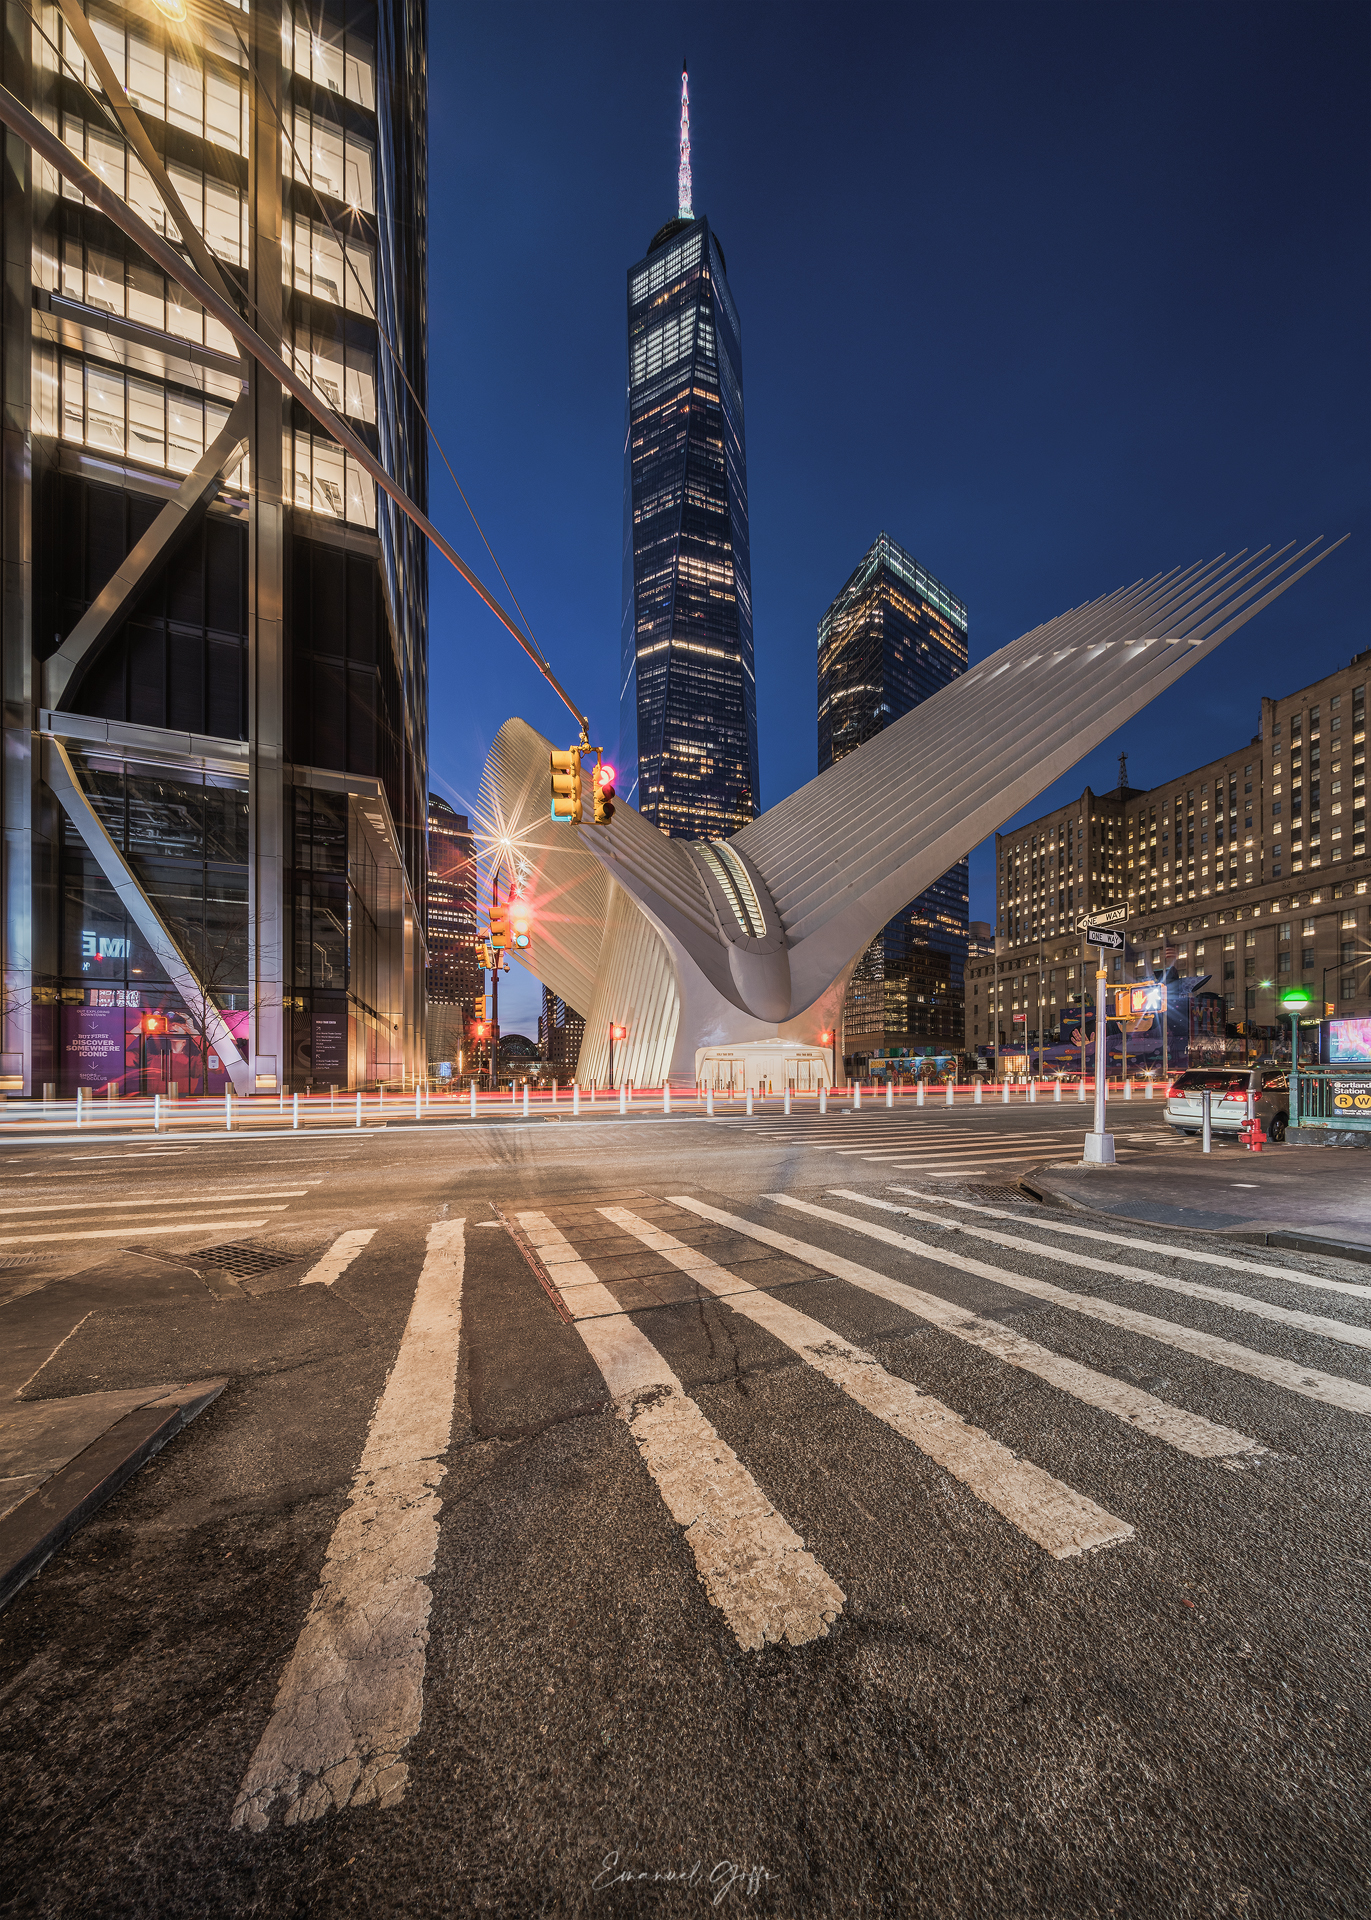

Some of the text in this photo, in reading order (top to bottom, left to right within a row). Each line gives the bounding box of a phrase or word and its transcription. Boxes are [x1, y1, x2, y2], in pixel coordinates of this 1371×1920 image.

[1082, 909, 1123, 927] ONE WAY
[1091, 932, 1119, 944] ONE WAY
